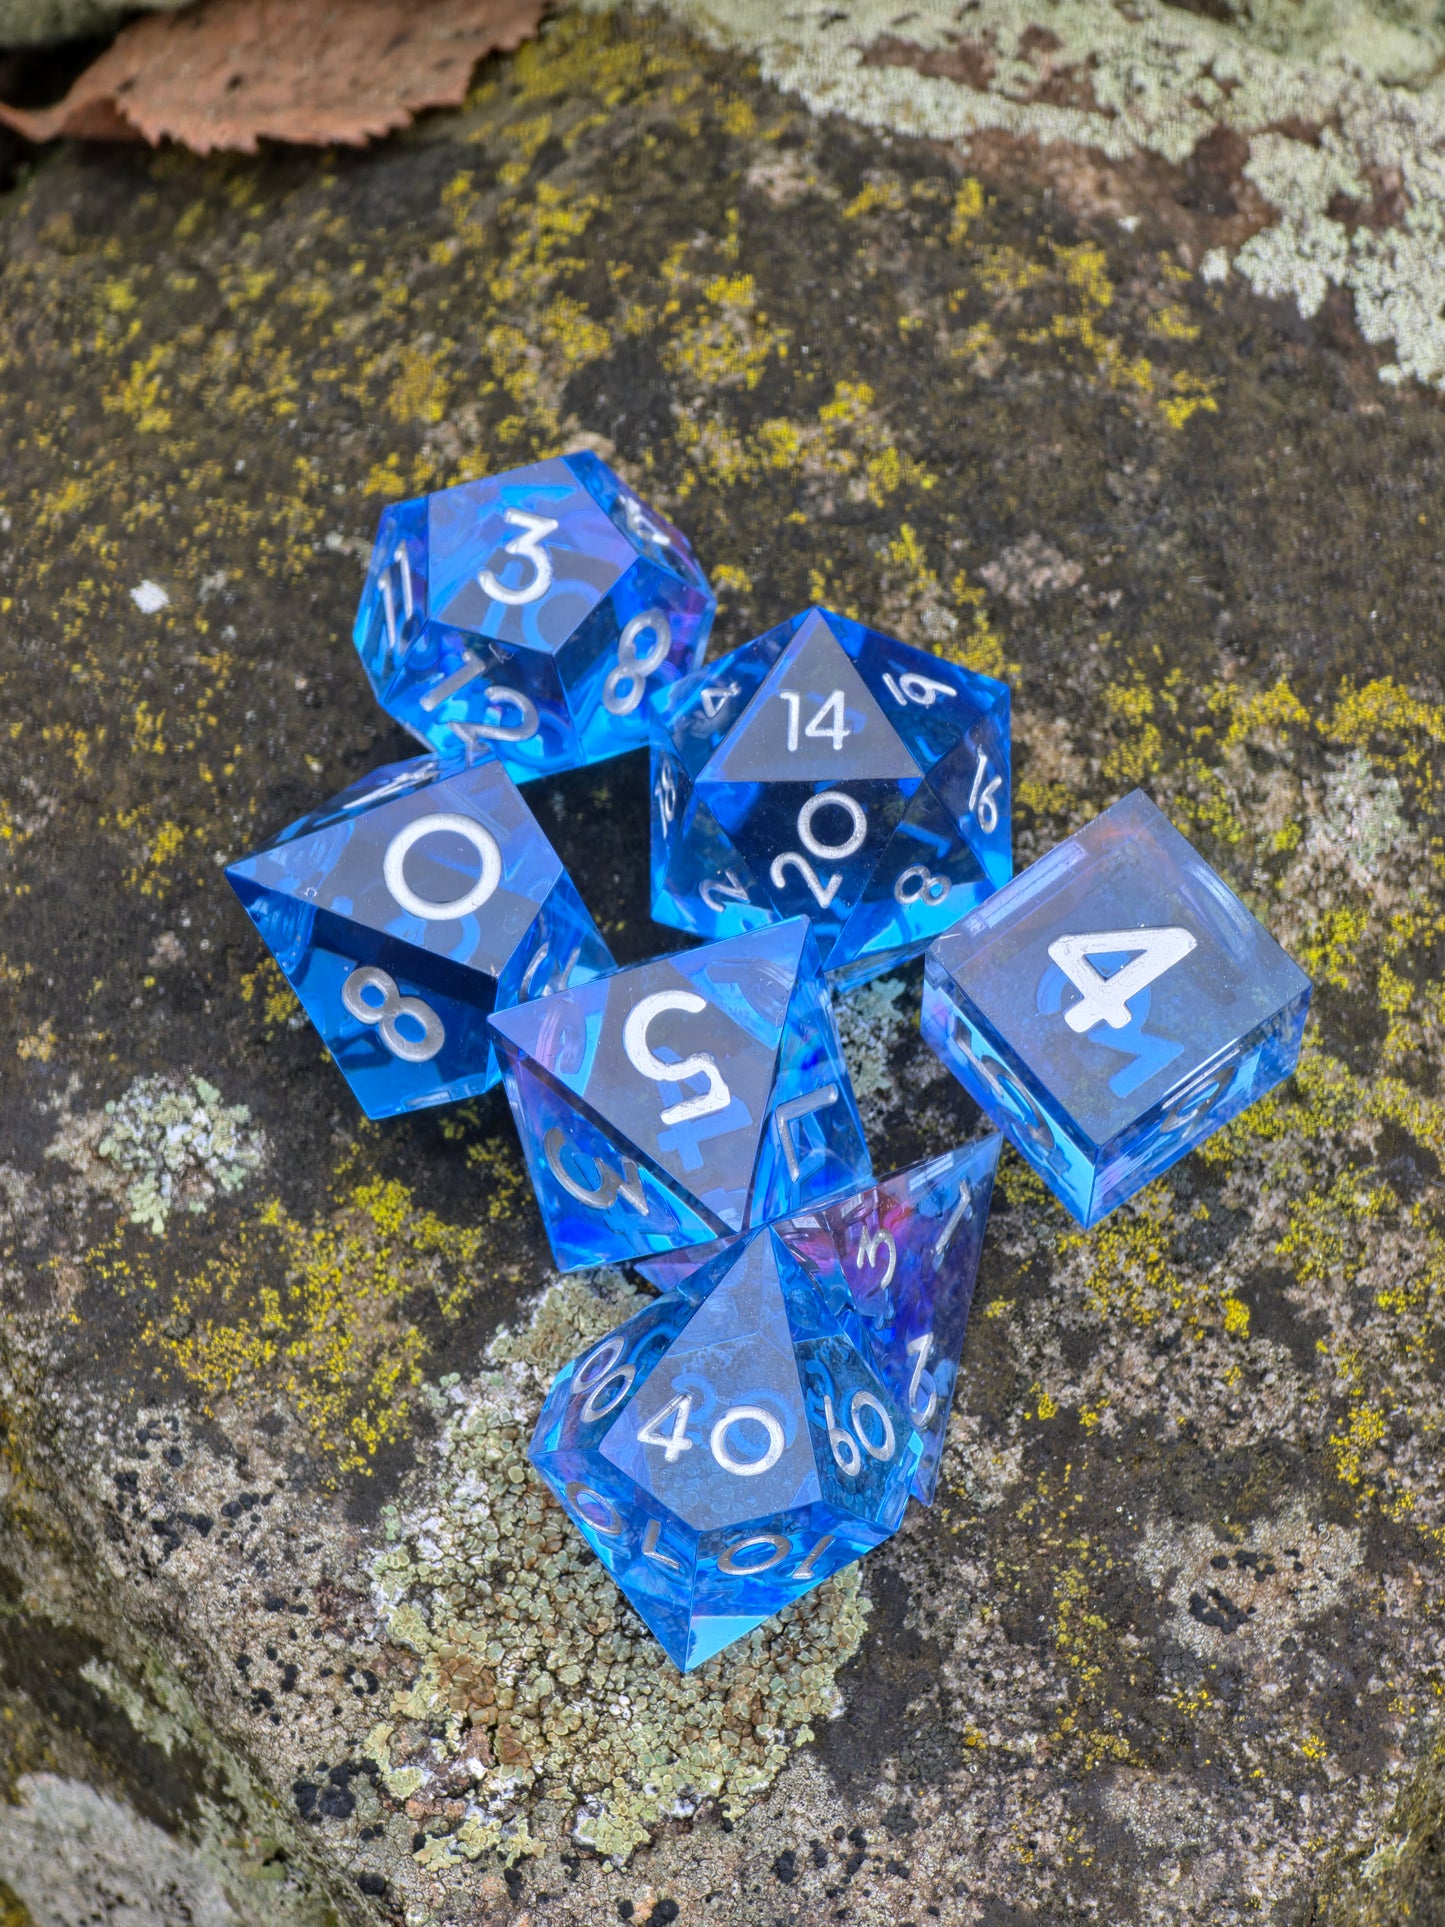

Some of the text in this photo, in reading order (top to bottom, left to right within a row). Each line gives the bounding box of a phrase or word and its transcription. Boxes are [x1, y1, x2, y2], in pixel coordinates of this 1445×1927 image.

[377, 540, 413, 648] 11
[477, 507, 559, 605] 3
[603, 609, 671, 715] 8
[780, 690, 851, 751] 14
[969, 745, 1002, 834] 16
[383, 813, 500, 920] 0
[770, 791, 867, 909] 20
[895, 865, 951, 906] 8
[341, 966, 445, 1063] 8
[1048, 927, 1197, 1033] 4
[623, 990, 730, 1124] 5
[637, 1392, 785, 1476] 40
[823, 1390, 895, 1476] 60
